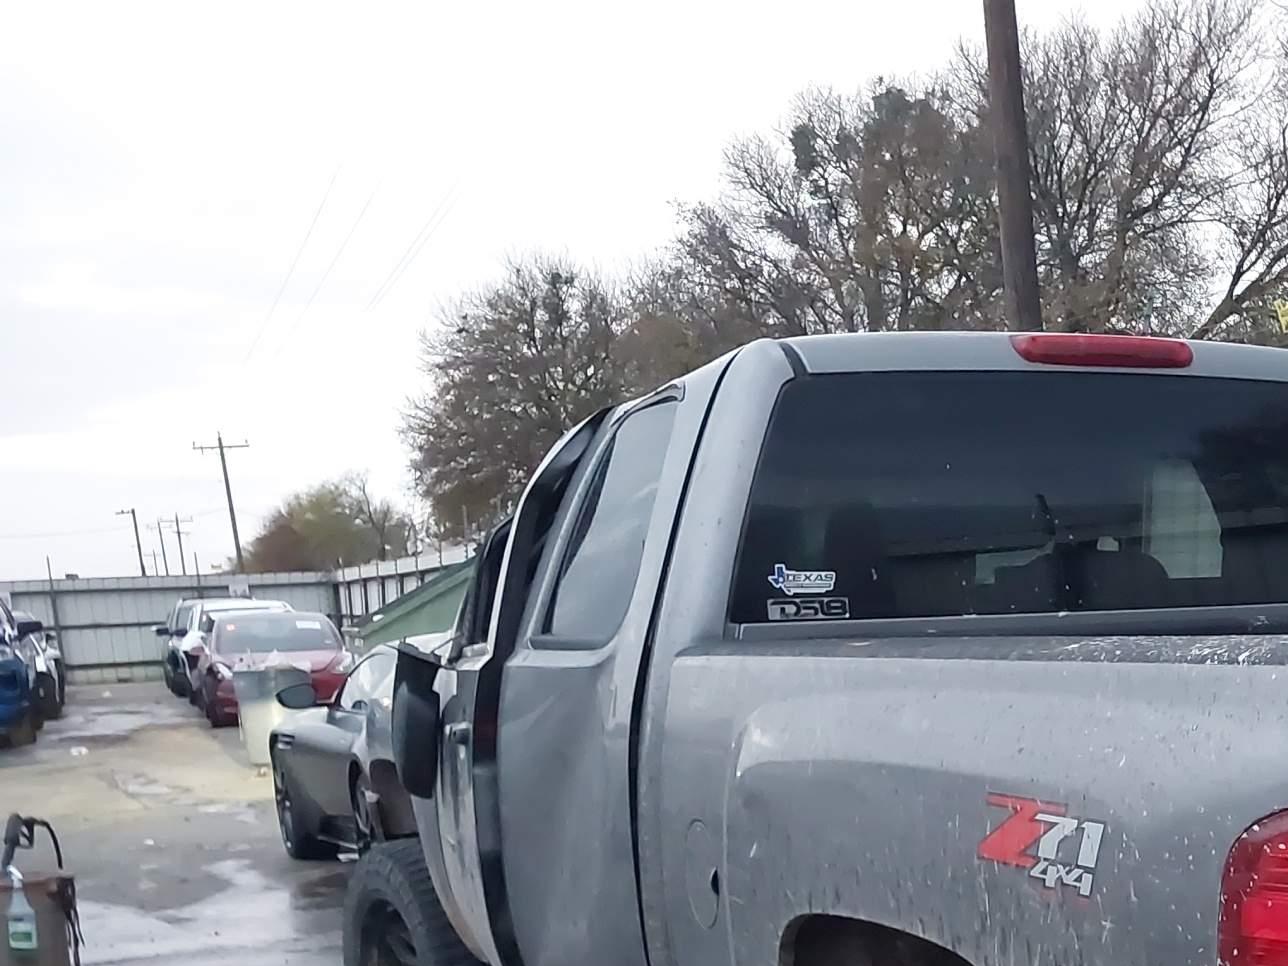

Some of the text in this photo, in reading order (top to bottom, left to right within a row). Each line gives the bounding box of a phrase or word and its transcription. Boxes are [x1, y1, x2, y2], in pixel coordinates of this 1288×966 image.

[785, 572, 834, 583] TEXAS
[768, 598, 849, 619] DS18
[977, 791, 1105, 869] Z71
